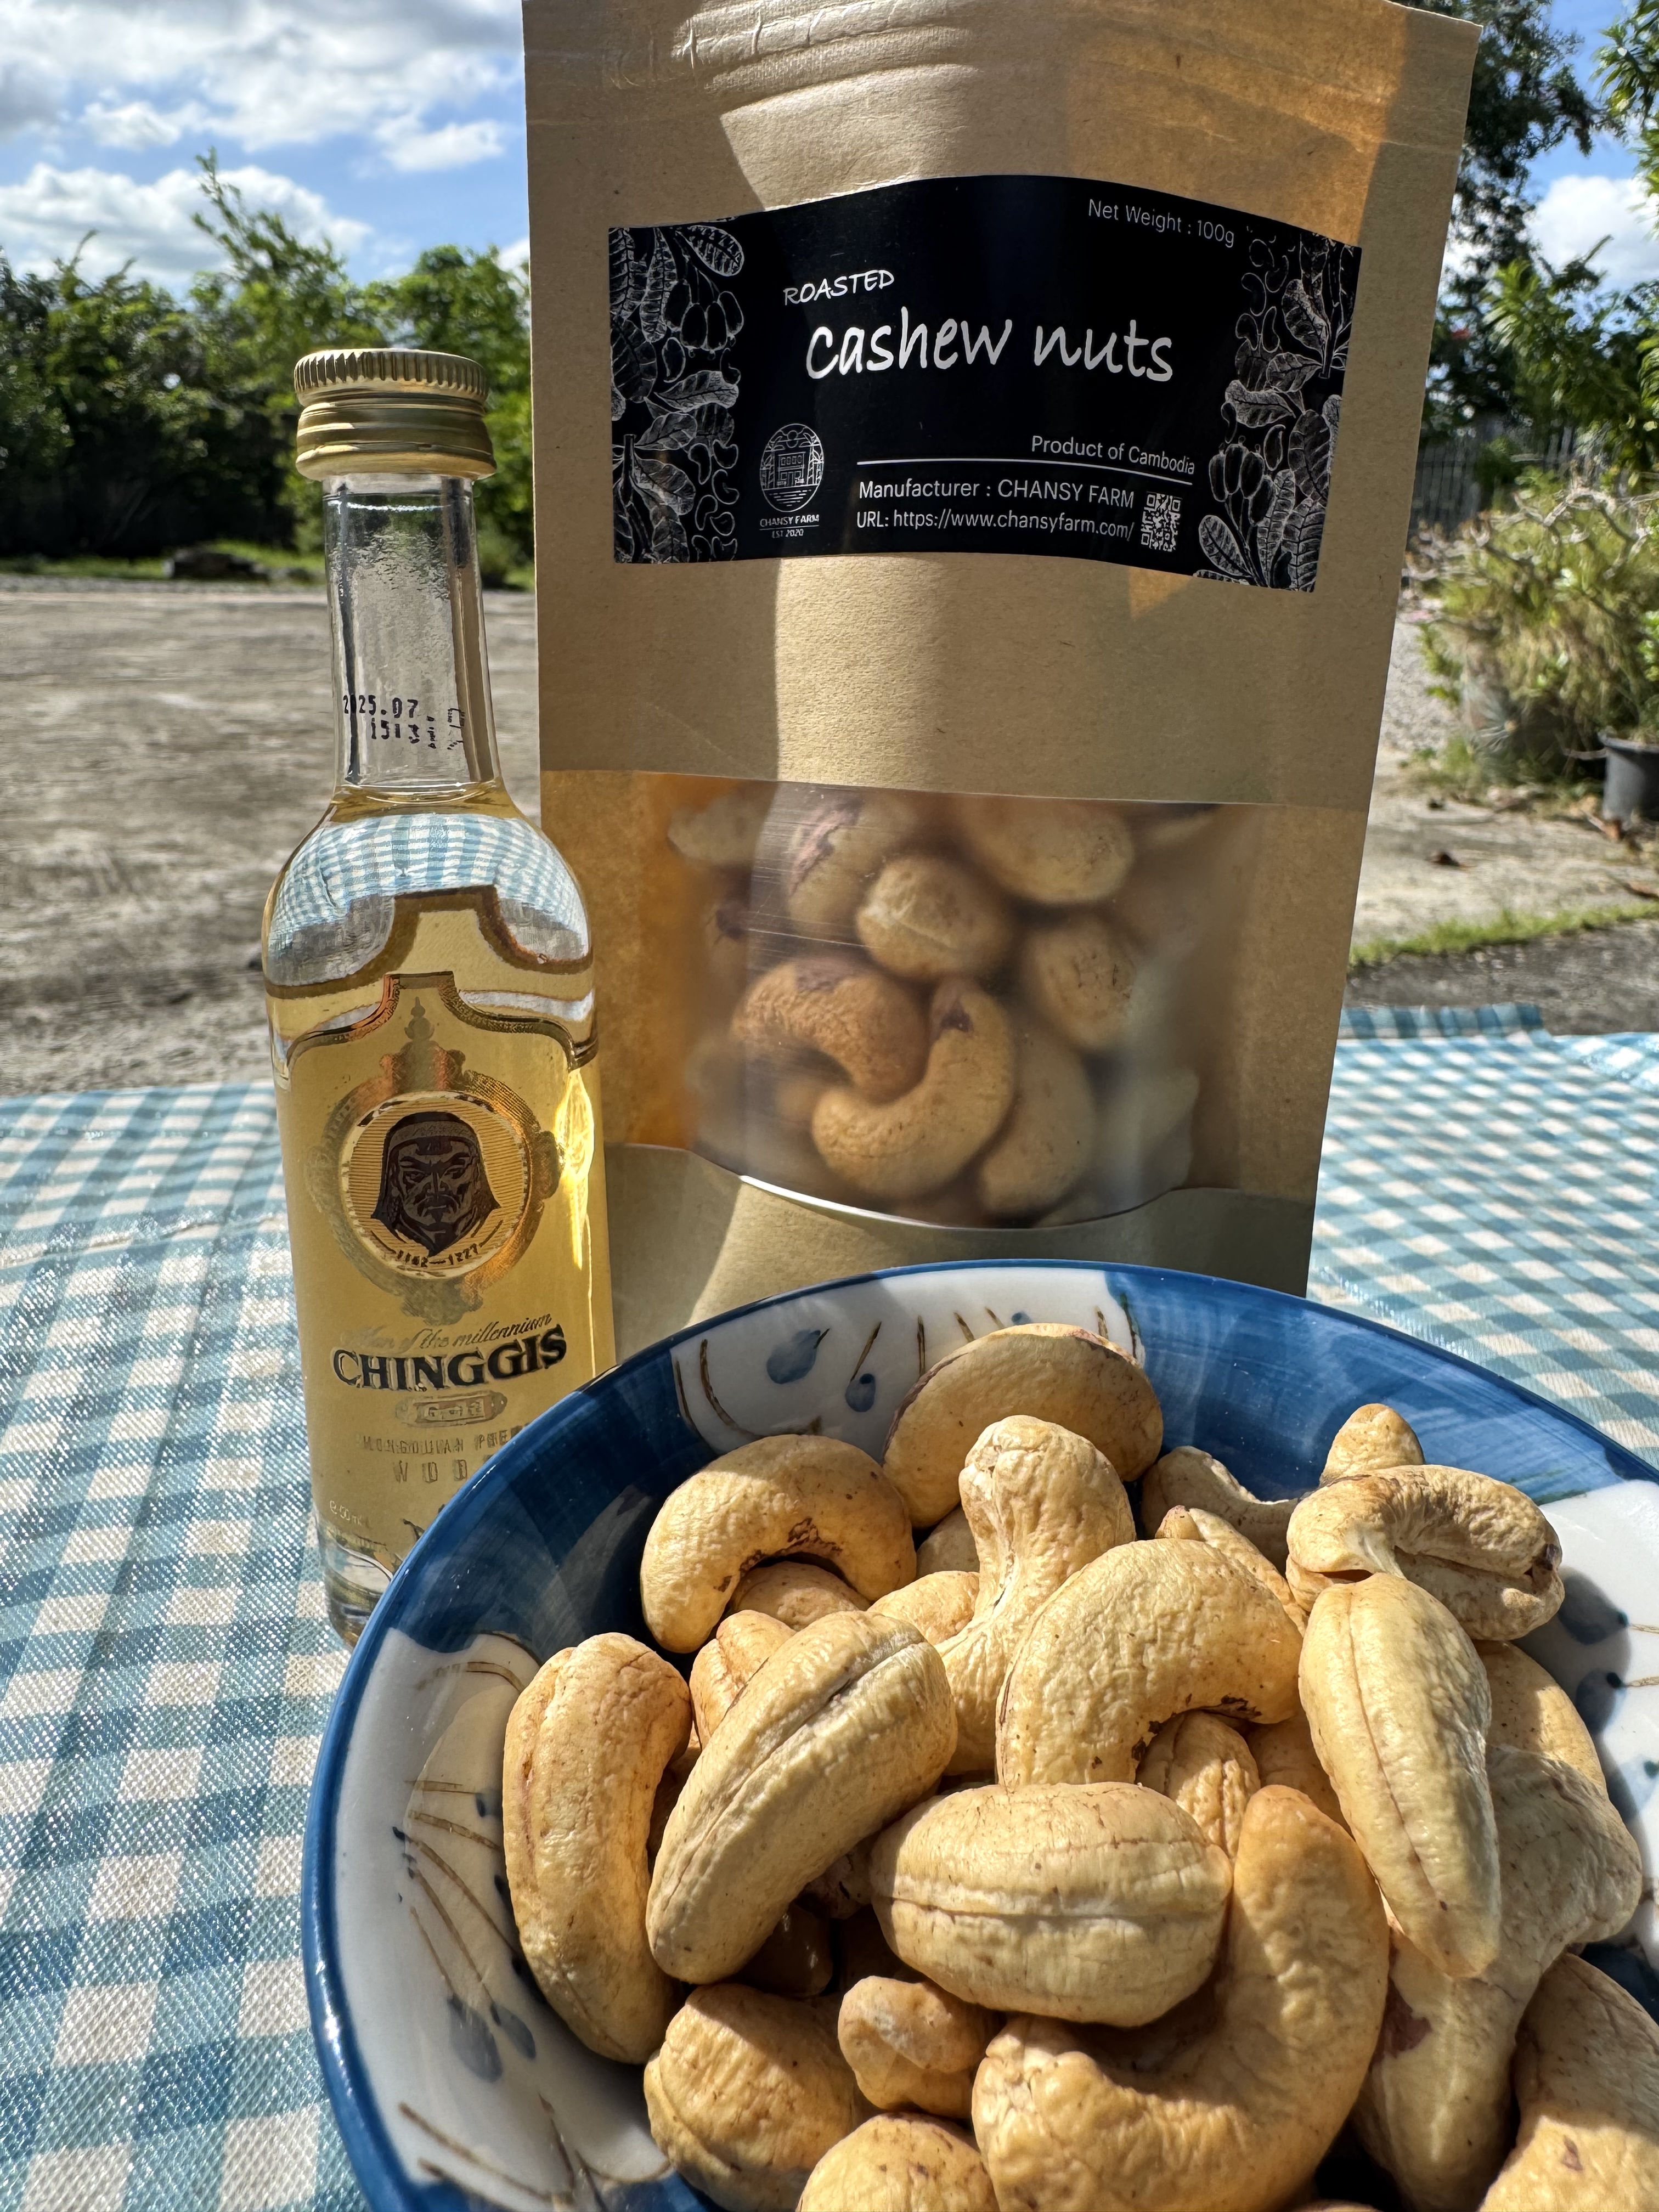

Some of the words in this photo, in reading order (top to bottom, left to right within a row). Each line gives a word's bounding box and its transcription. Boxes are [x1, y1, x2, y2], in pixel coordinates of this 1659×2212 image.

[1088, 199, 1119, 220] Net
[1126, 205, 1181, 233] Weight
[784, 269, 895, 305] ROASTED
[805, 306, 1013, 379] cashew
[1034, 319, 1173, 382] nuts
[1031, 436, 1103, 458] Product
[1107, 444, 1125, 460] of
[1128, 446, 1195, 475] Cambodia
[859, 478, 980, 499] Manufacturer
[997, 479, 1083, 501] CHANSY
[1089, 485, 1134, 509] FARM
[856, 511, 889, 528] URL:
[893, 508, 1135, 542] https://www.chansyfarm.com/
[452, 1313, 552, 1346] millennium
[333, 1323, 567, 1392] CHINGGIS
